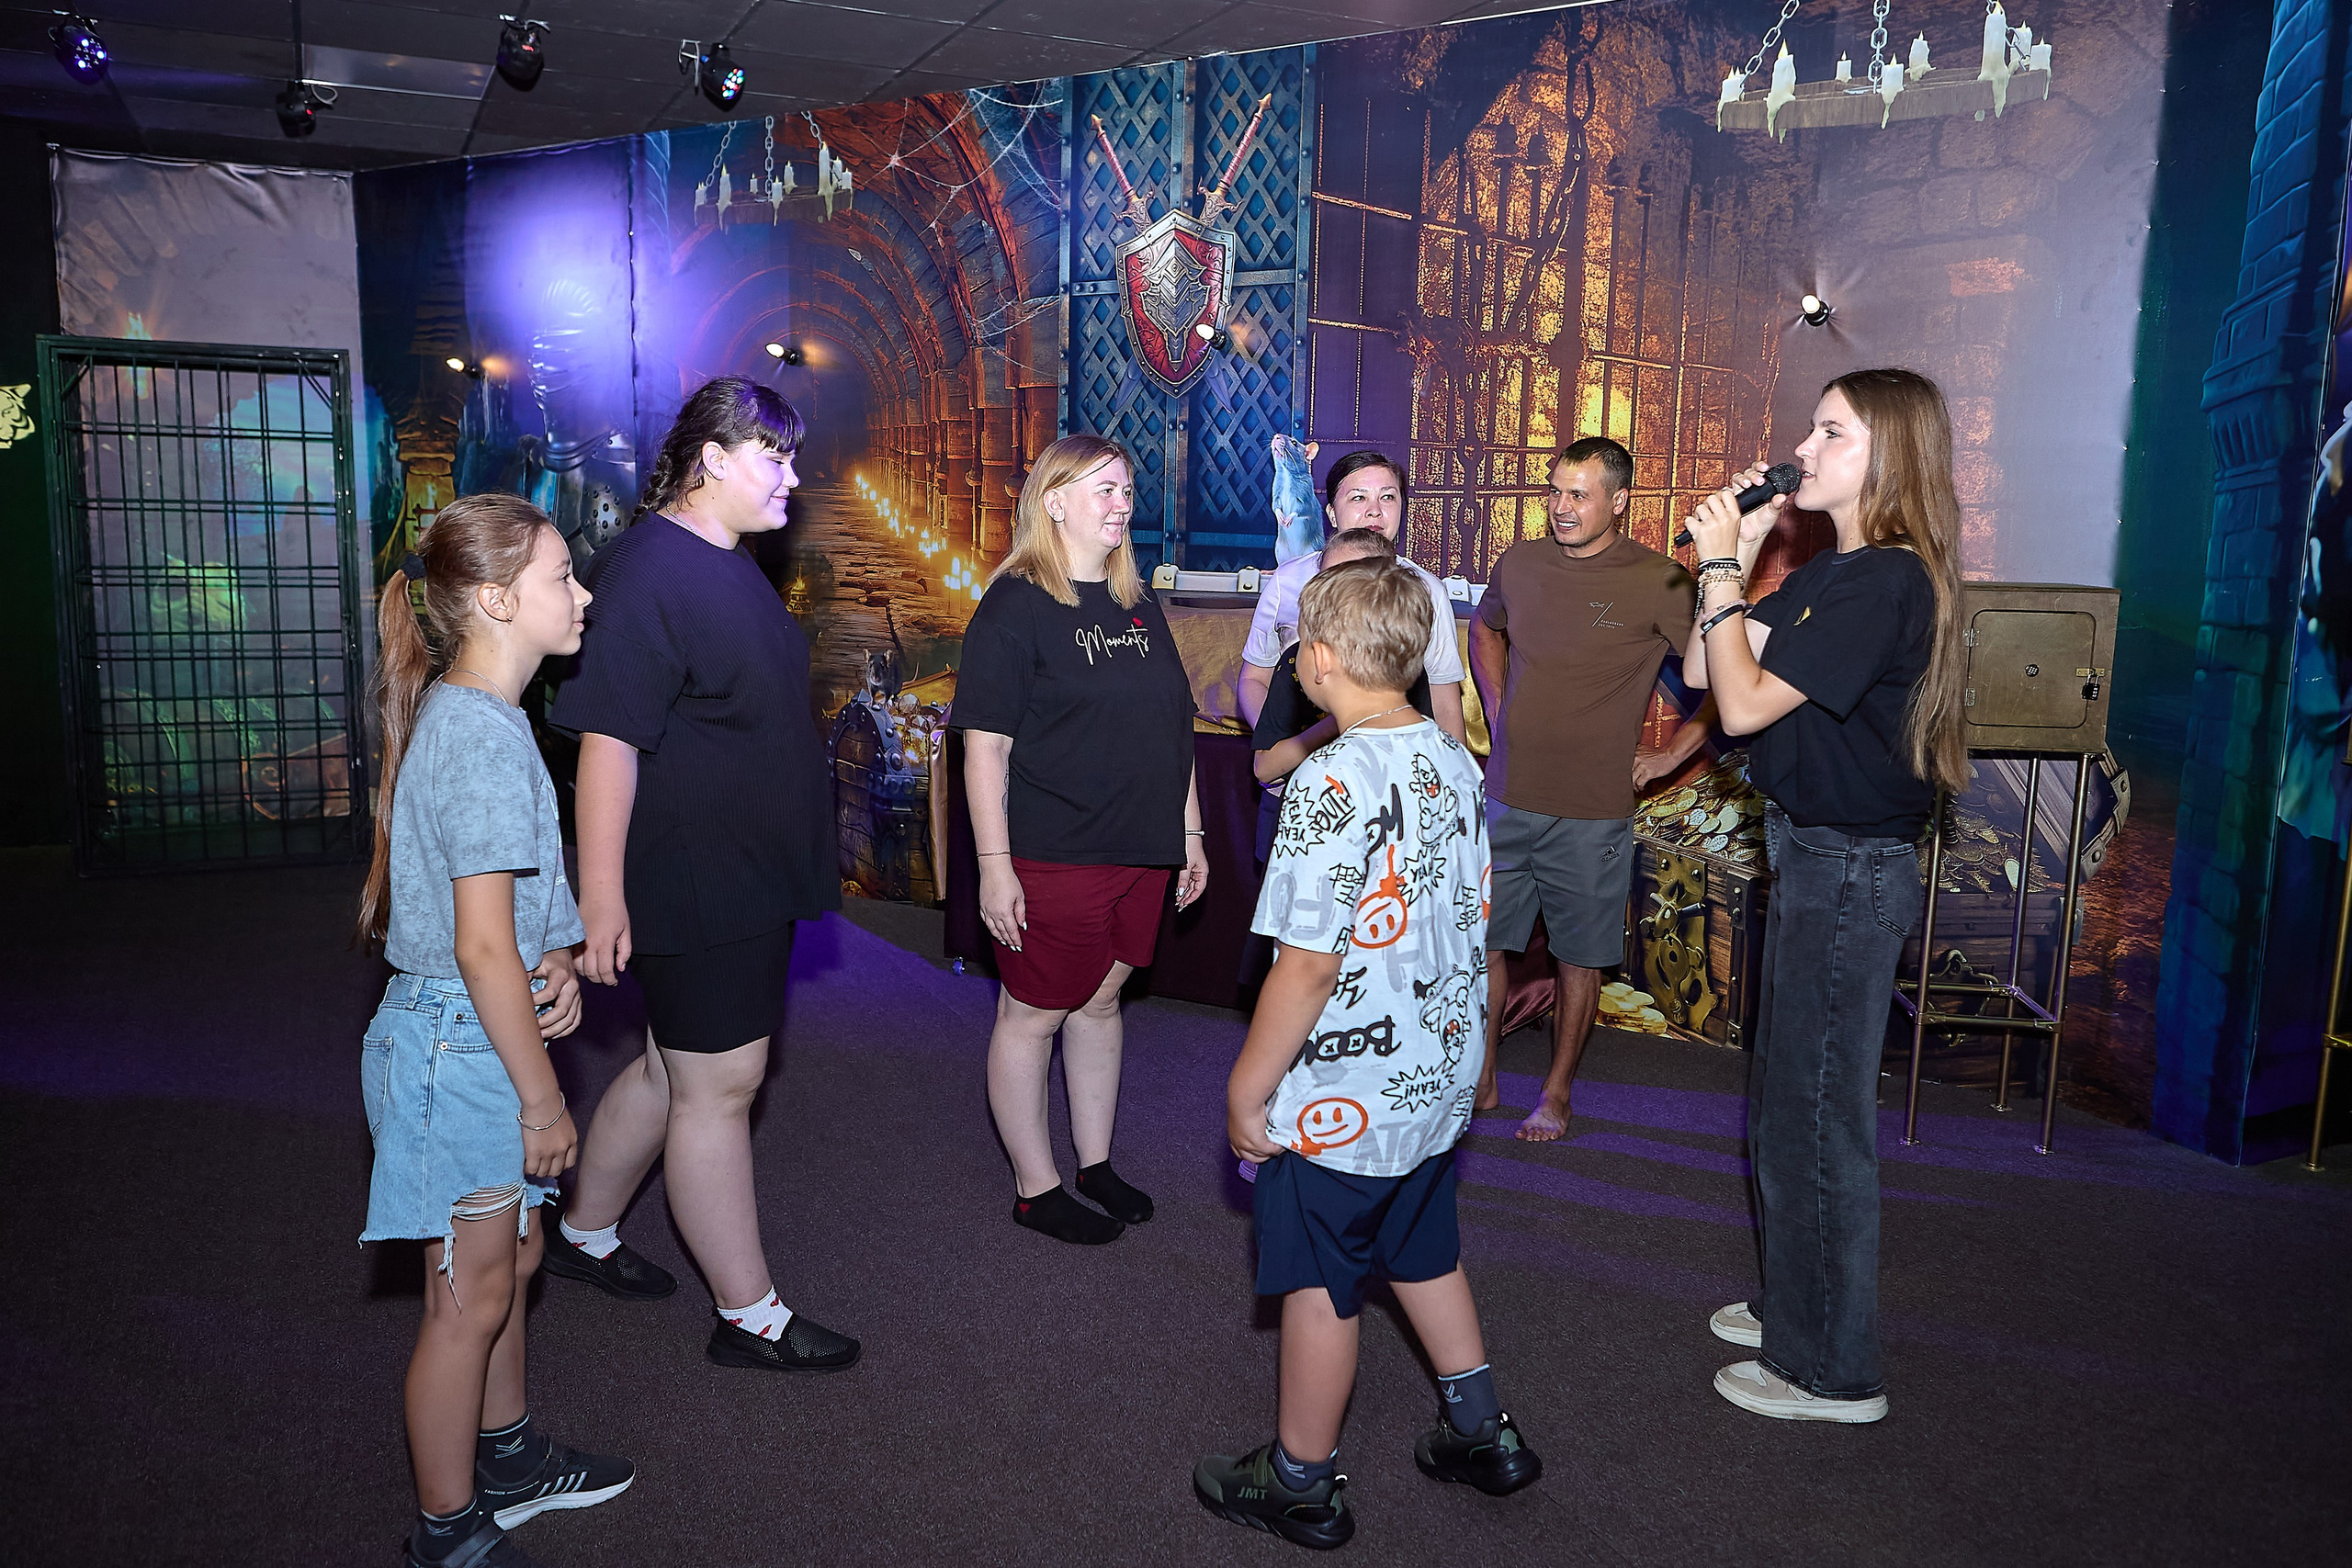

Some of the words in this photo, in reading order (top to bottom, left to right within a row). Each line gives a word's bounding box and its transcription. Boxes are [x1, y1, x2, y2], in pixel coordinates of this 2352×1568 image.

[1075, 624, 1149, 666] Moments
[1404, 1078, 1441, 1100] YEAH!
[1238, 1485, 1268, 1501] JMT
